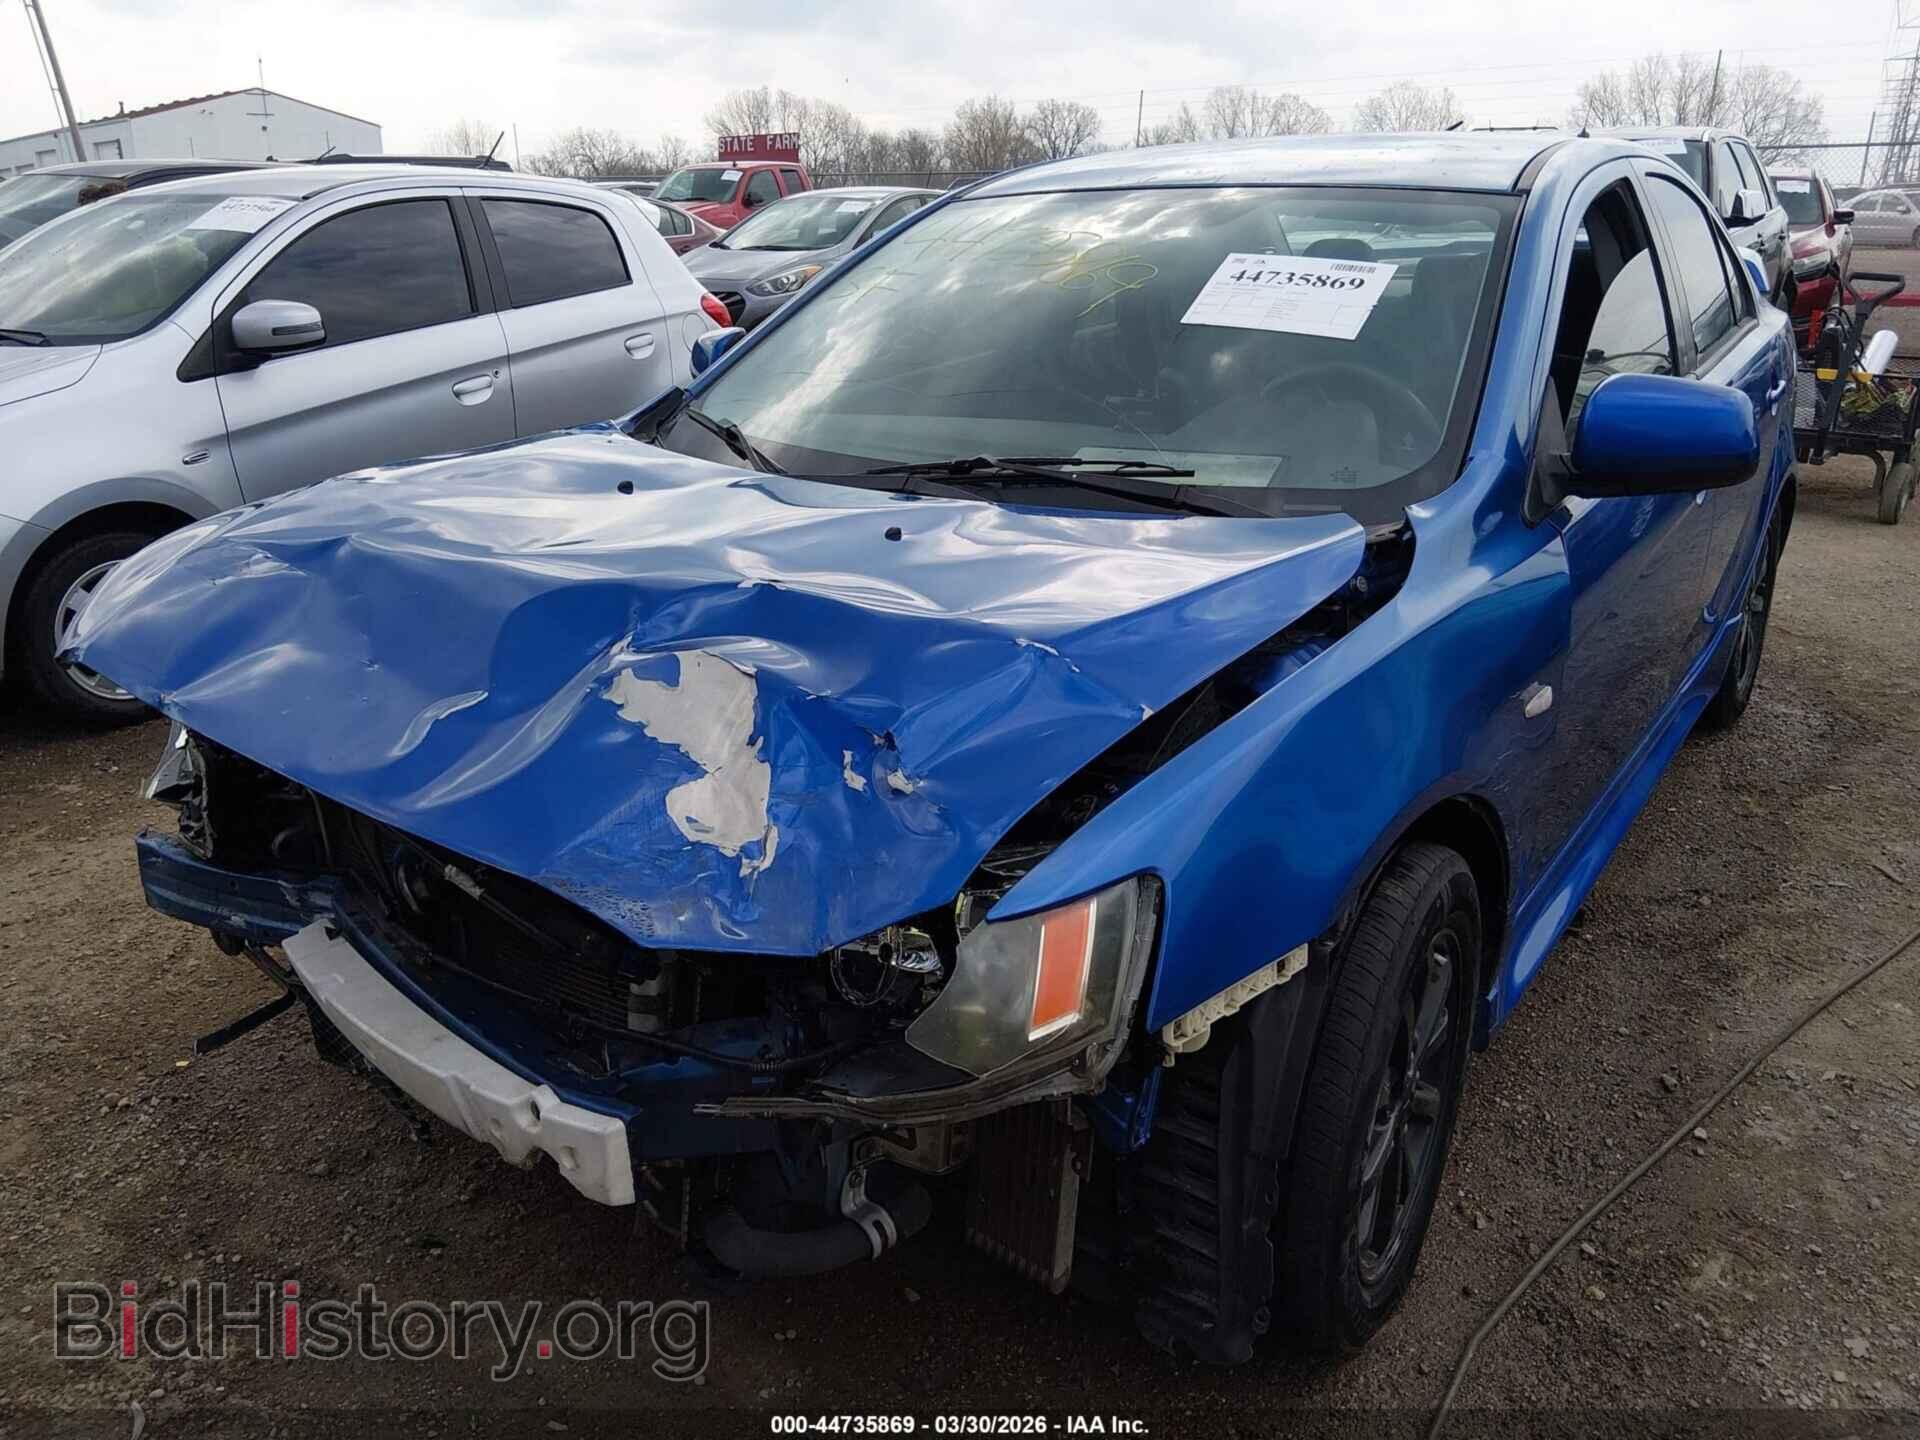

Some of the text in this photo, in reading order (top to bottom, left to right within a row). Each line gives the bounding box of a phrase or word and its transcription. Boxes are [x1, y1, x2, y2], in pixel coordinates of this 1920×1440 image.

[719, 133, 799, 153] STATE FARM
[1229, 269, 1366, 291] 44735869
